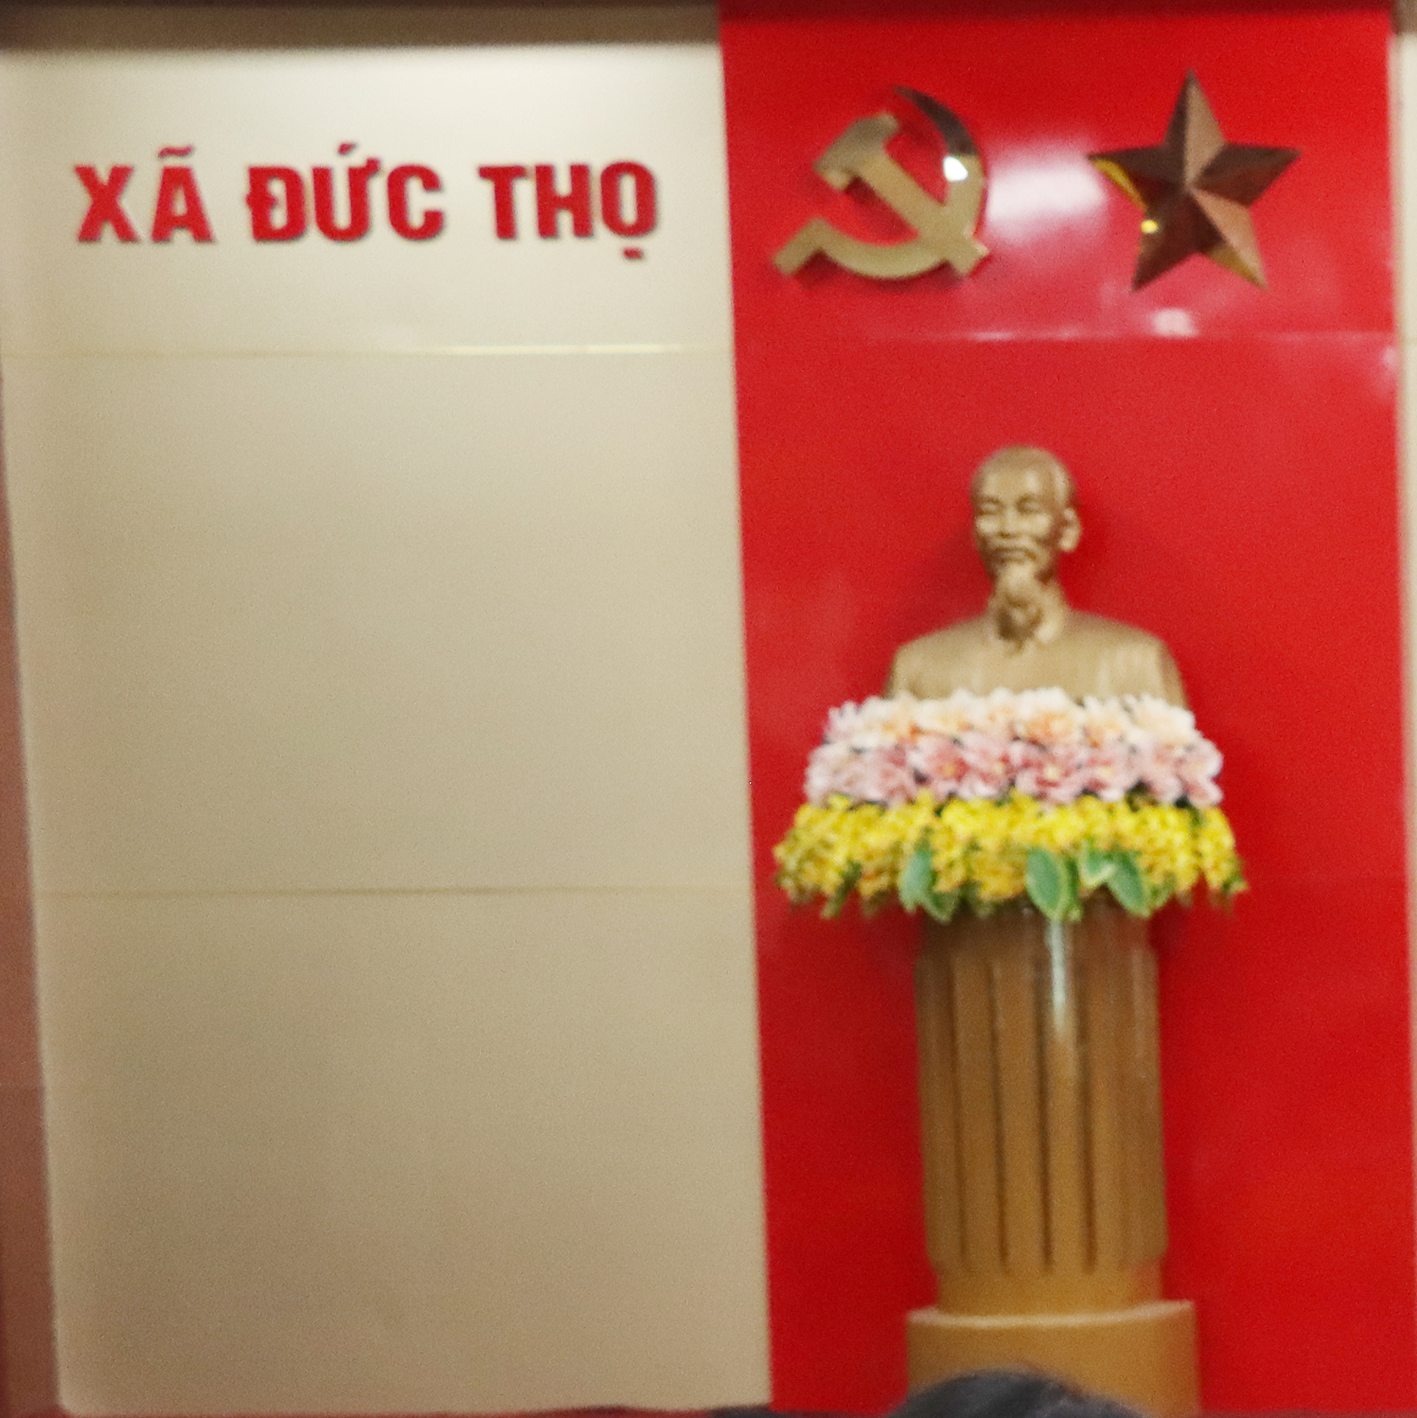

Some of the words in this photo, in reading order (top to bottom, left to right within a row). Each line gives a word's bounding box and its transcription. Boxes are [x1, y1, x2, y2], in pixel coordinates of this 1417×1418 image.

[75, 146, 213, 243] XÃ
[244, 142, 444, 243] ĐỨC
[477, 160, 658, 260] THỌ
